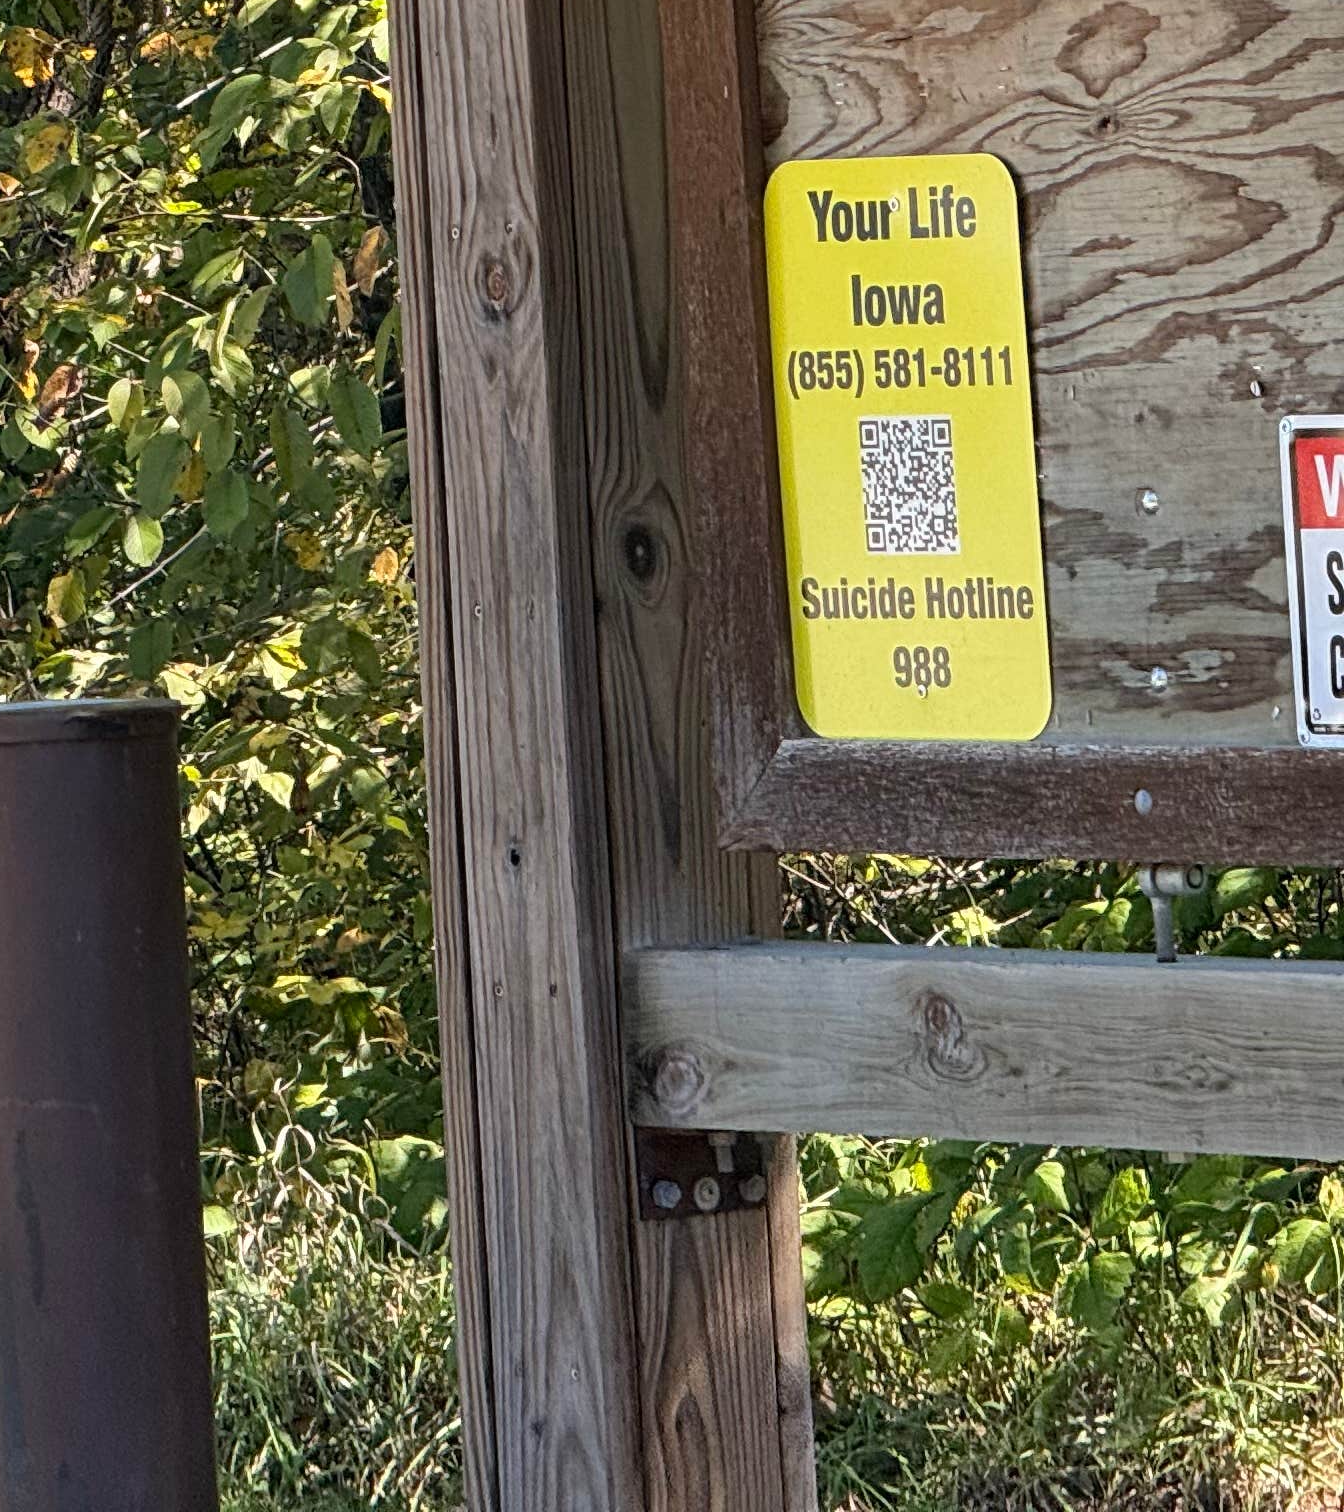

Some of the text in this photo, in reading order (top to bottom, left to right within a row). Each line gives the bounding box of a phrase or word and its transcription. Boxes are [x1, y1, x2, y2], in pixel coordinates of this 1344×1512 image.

[807, 185, 977, 243] Your Life
[851, 274, 945, 326] Iowa
[787, 345, 1013, 399] (855) 581-8111
[802, 576, 1034, 620] Suicide Hotline
[893, 645, 952, 688] 988
